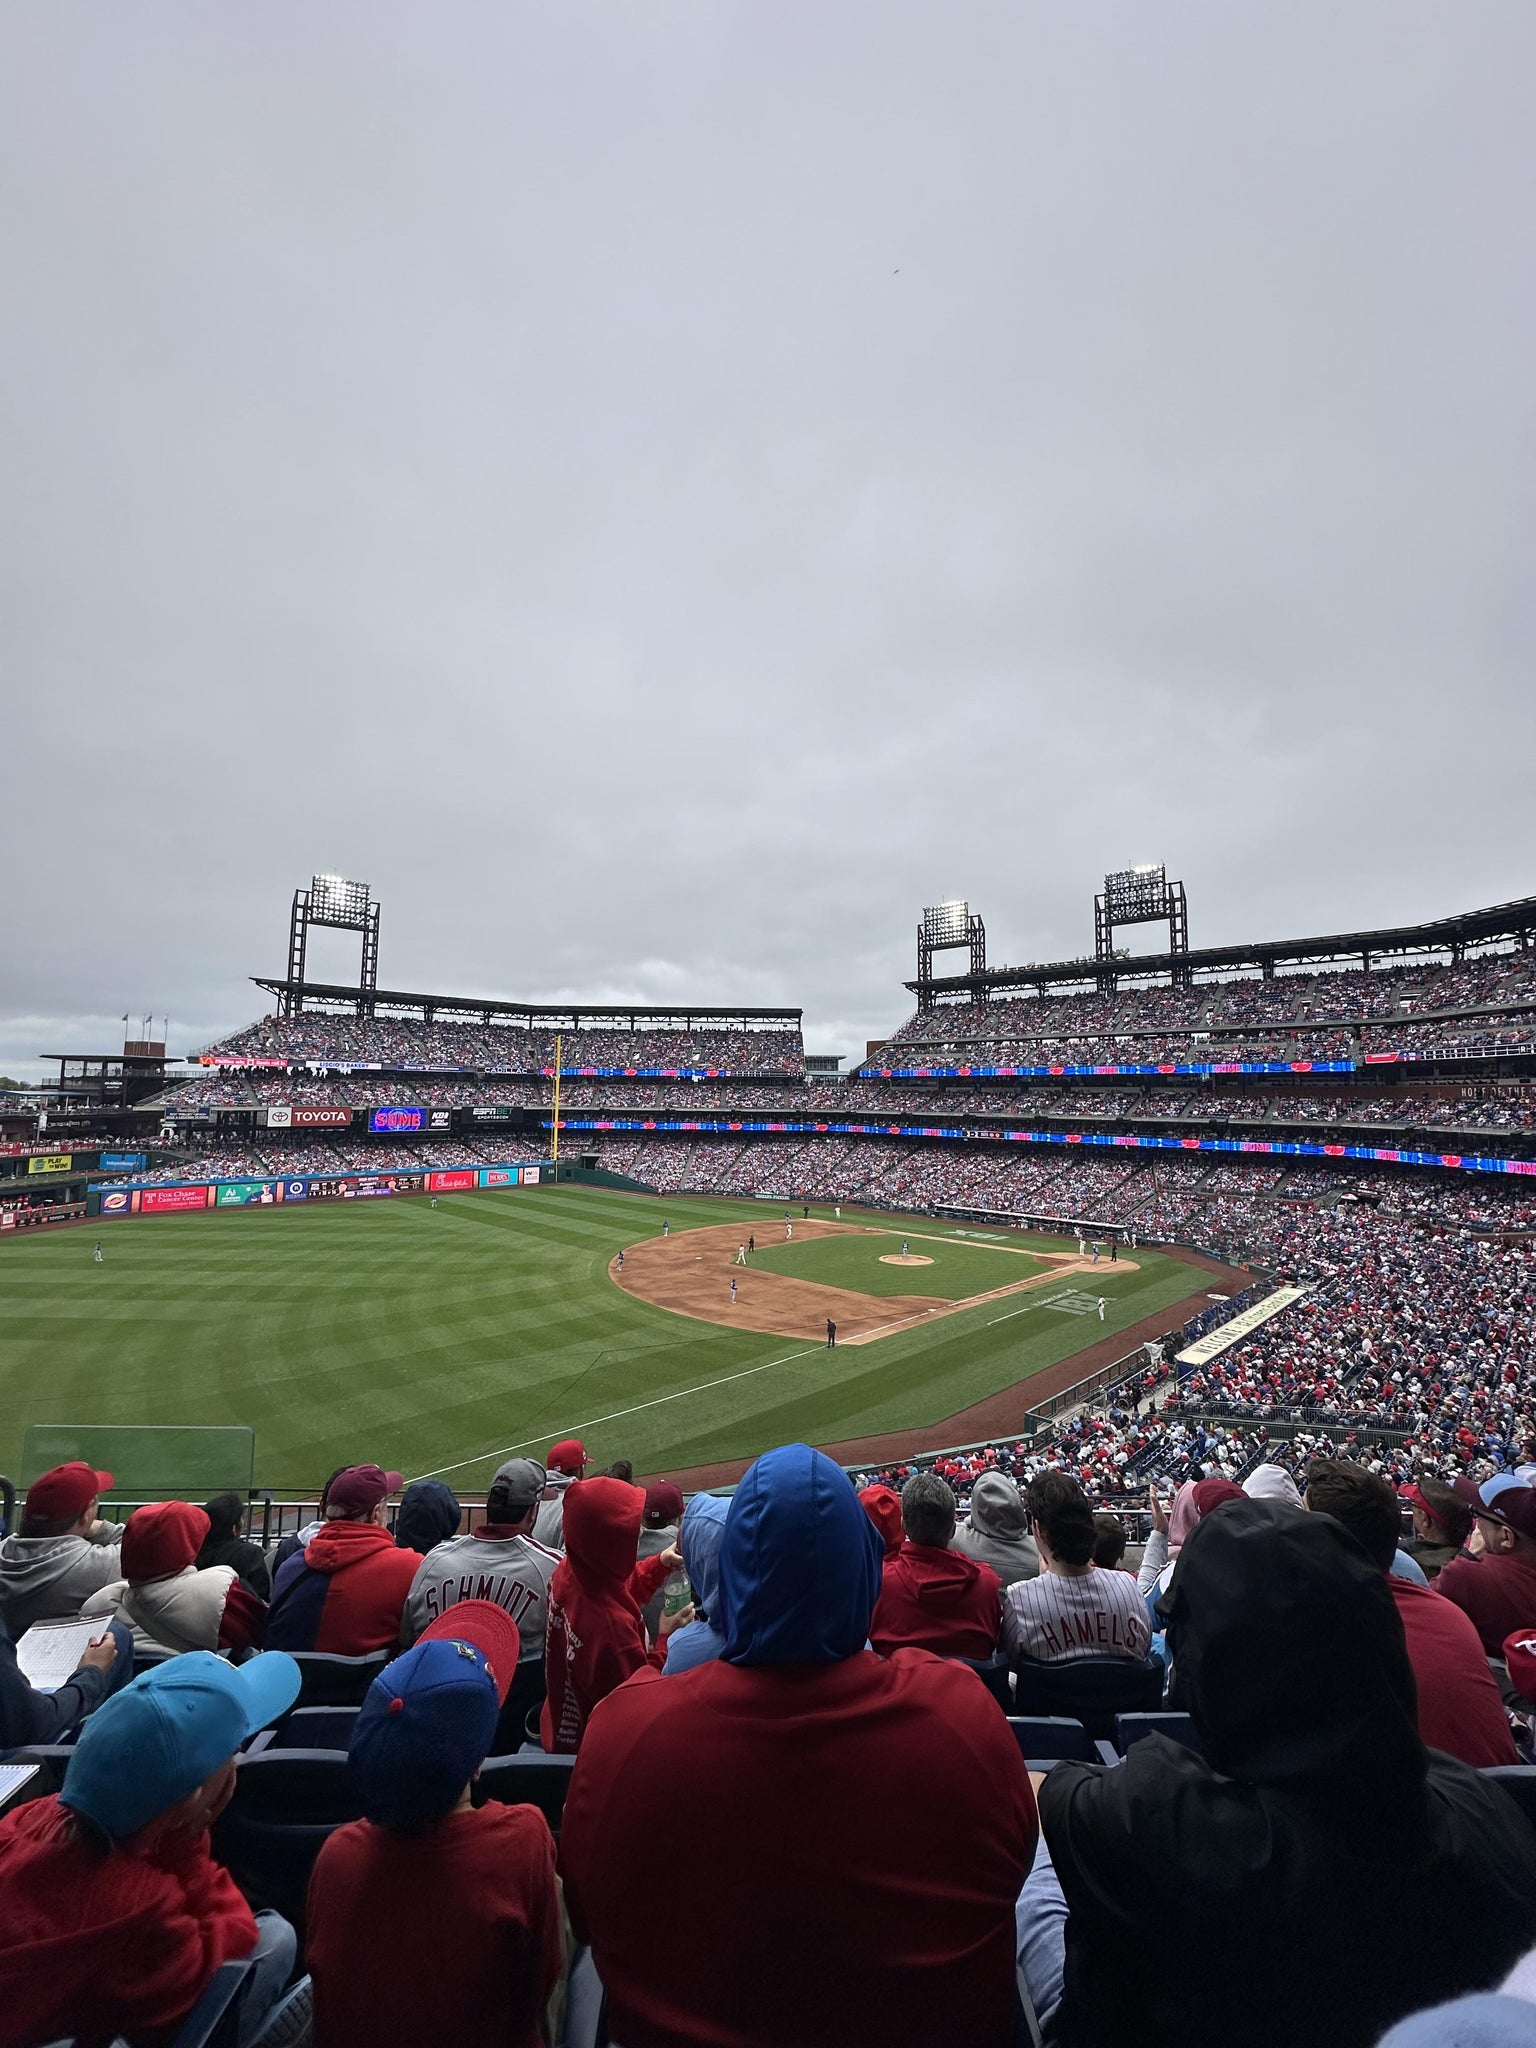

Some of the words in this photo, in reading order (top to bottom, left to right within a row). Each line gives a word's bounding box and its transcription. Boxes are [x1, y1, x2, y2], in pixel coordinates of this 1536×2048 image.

[484, 1066, 528, 1074] CADILLAC
[294, 1111, 347, 1122] TOYOTA
[473, 1107, 496, 1115] ESPN
[497, 1107, 513, 1115] BET
[374, 1112, 421, 1126] SOME
[173, 1190, 197, 1198] Chase
[157, 1196, 181, 1204] Cancer
[1192, 1327, 1243, 1355] WELCOME
[425, 1574, 540, 1625] SCHMIDT
[1040, 1610, 1138, 1654] HAMELS
